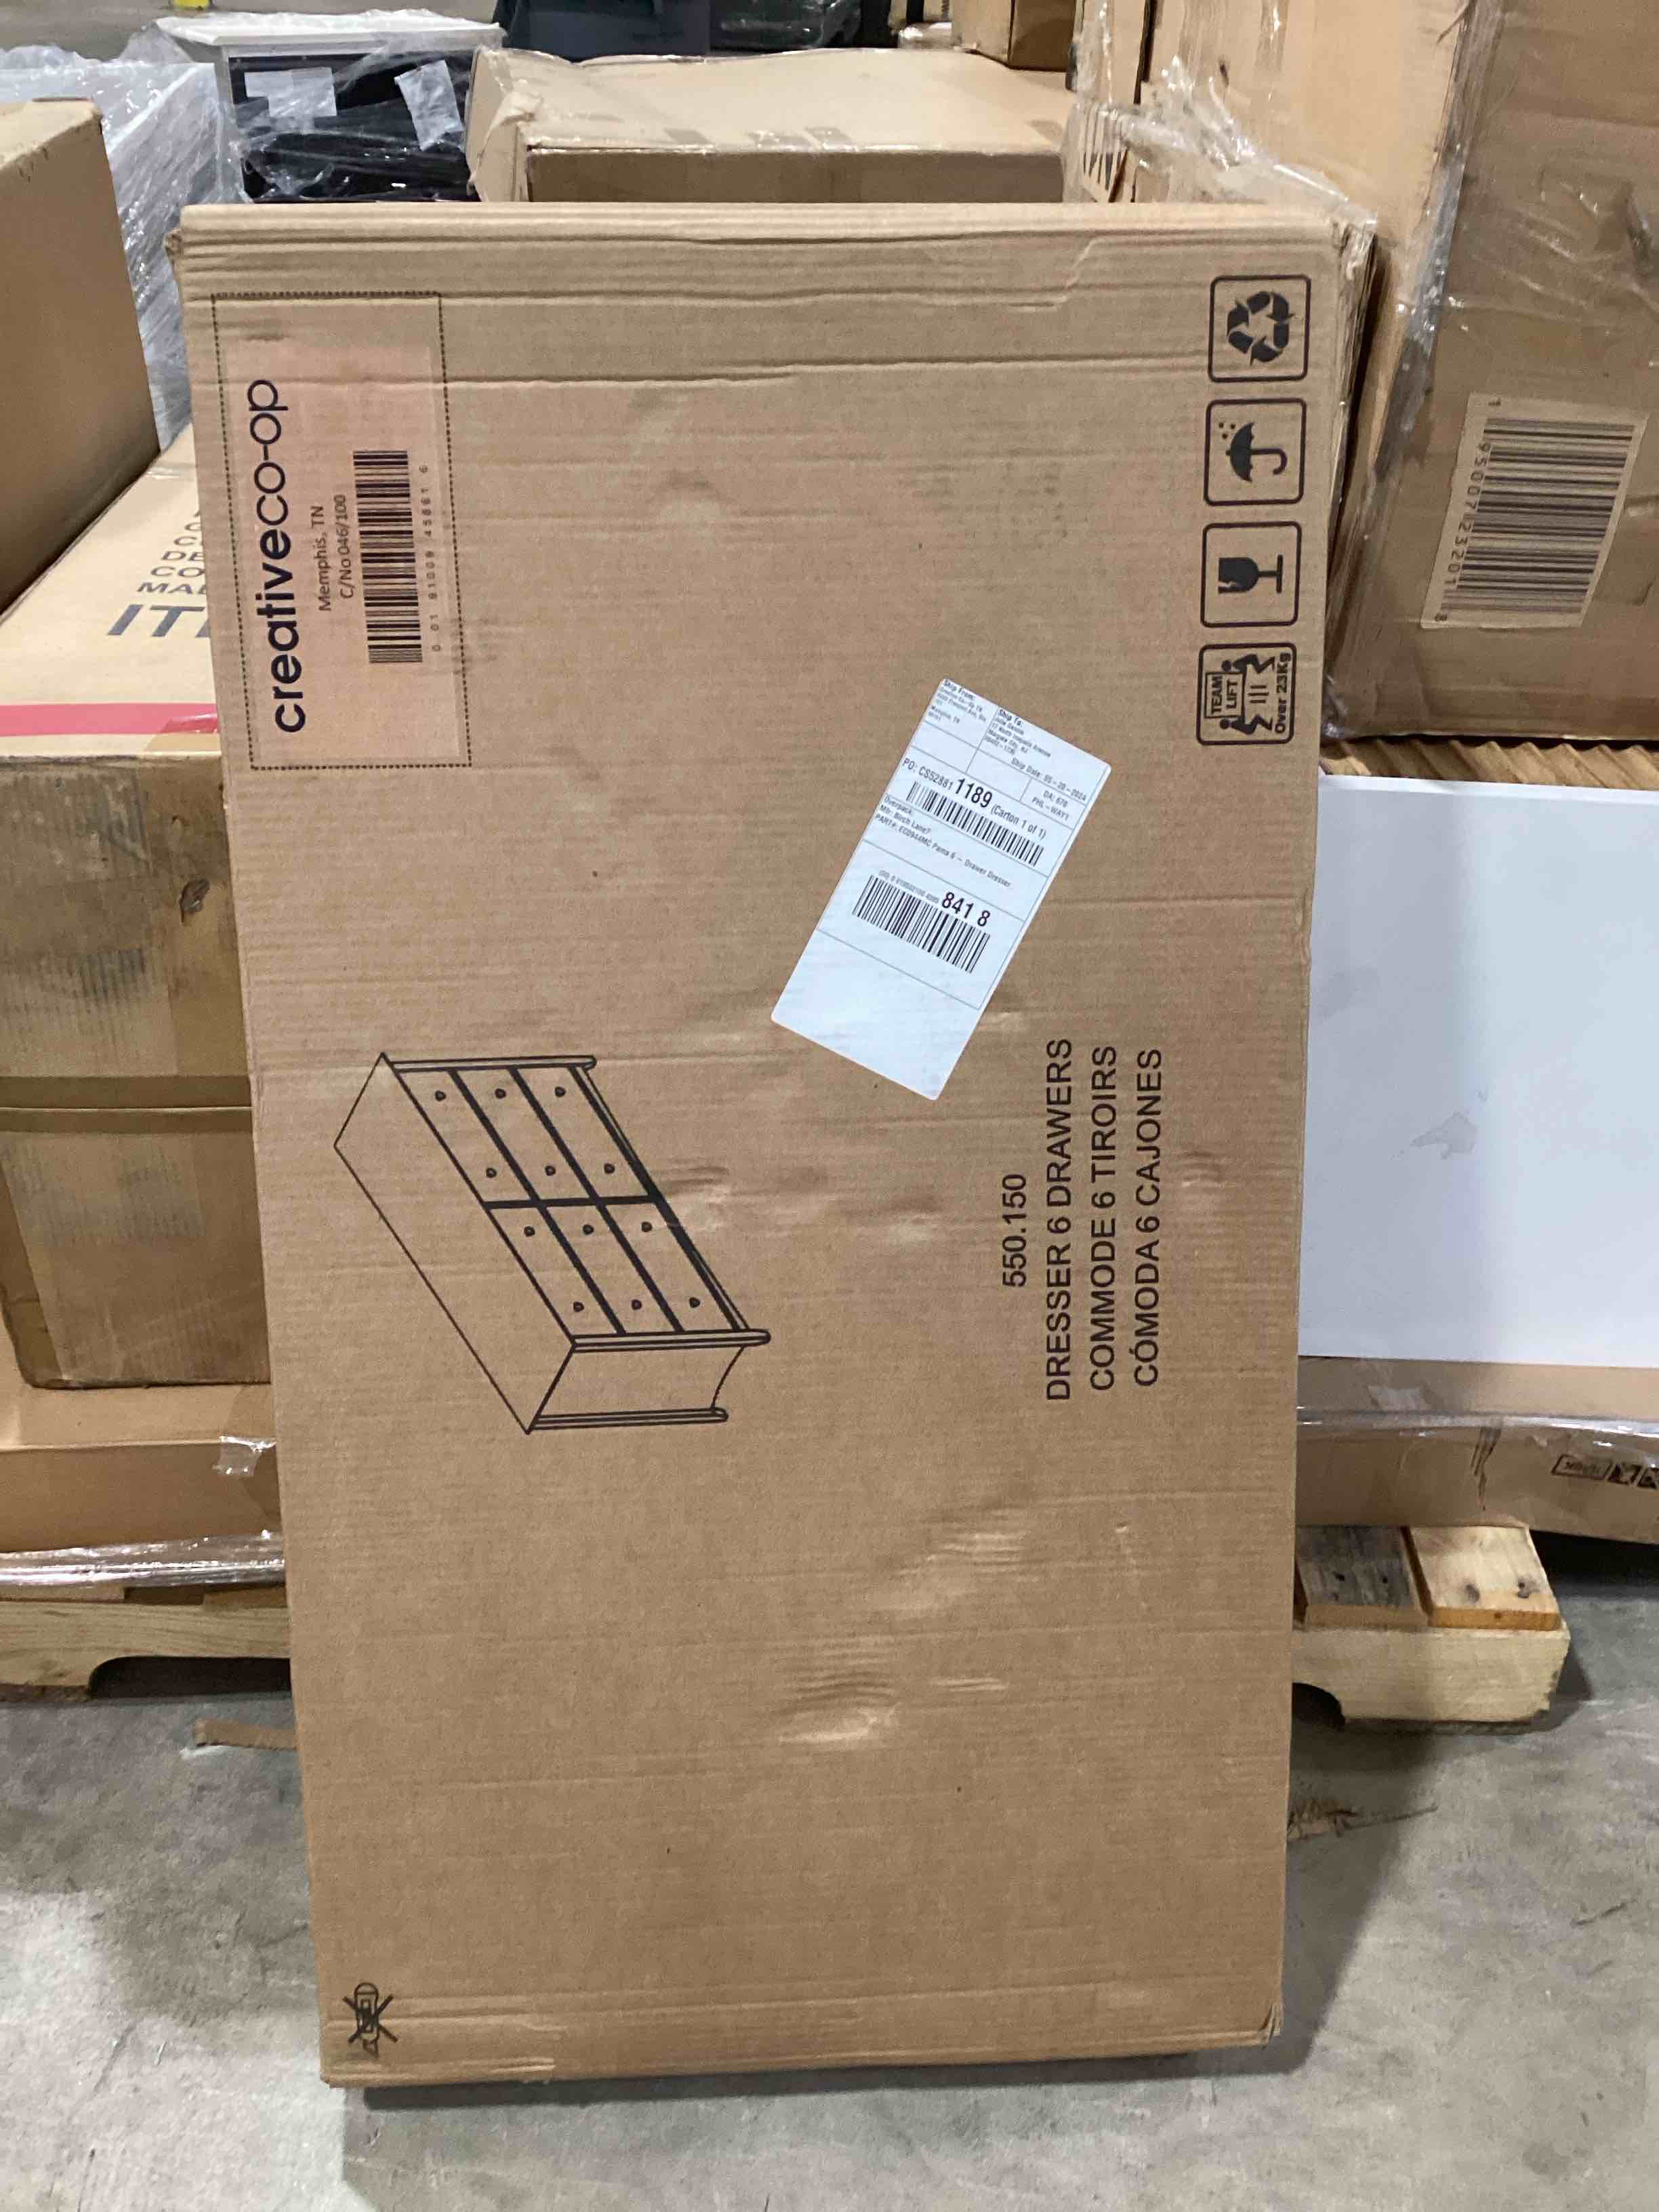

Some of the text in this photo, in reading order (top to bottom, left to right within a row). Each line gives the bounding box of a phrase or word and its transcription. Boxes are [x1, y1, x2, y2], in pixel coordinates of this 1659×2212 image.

[311, 506, 331, 611] Memphis, TN
[998, 710, 1012, 721] Ship
[1210, 675, 1223, 714] TEAM
[1225, 679, 1237, 709] LIFT
[1275, 653, 1291, 733] Over 23Kg
[902, 758, 918, 772] PO:
[952, 777, 994, 809] 1189
[990, 804, 1020, 826] (Carton
[1027, 823, 1037, 834] of
[1036, 828, 1047, 840] 1)
[1010, 758, 1025, 770] Ship
[894, 813, 911, 824] Birch
[987, 871, 1011, 887] Dresser
[1002, 1174, 1027, 1287] 550.150
[1046, 1039, 1072, 1400] DRESSER 6 DRAWERS
[1089, 1046, 1117, 1390] COMMODE 6 TIROIRS
[1128, 1049, 1162, 1386] CÓMODA 6 CAJONES
